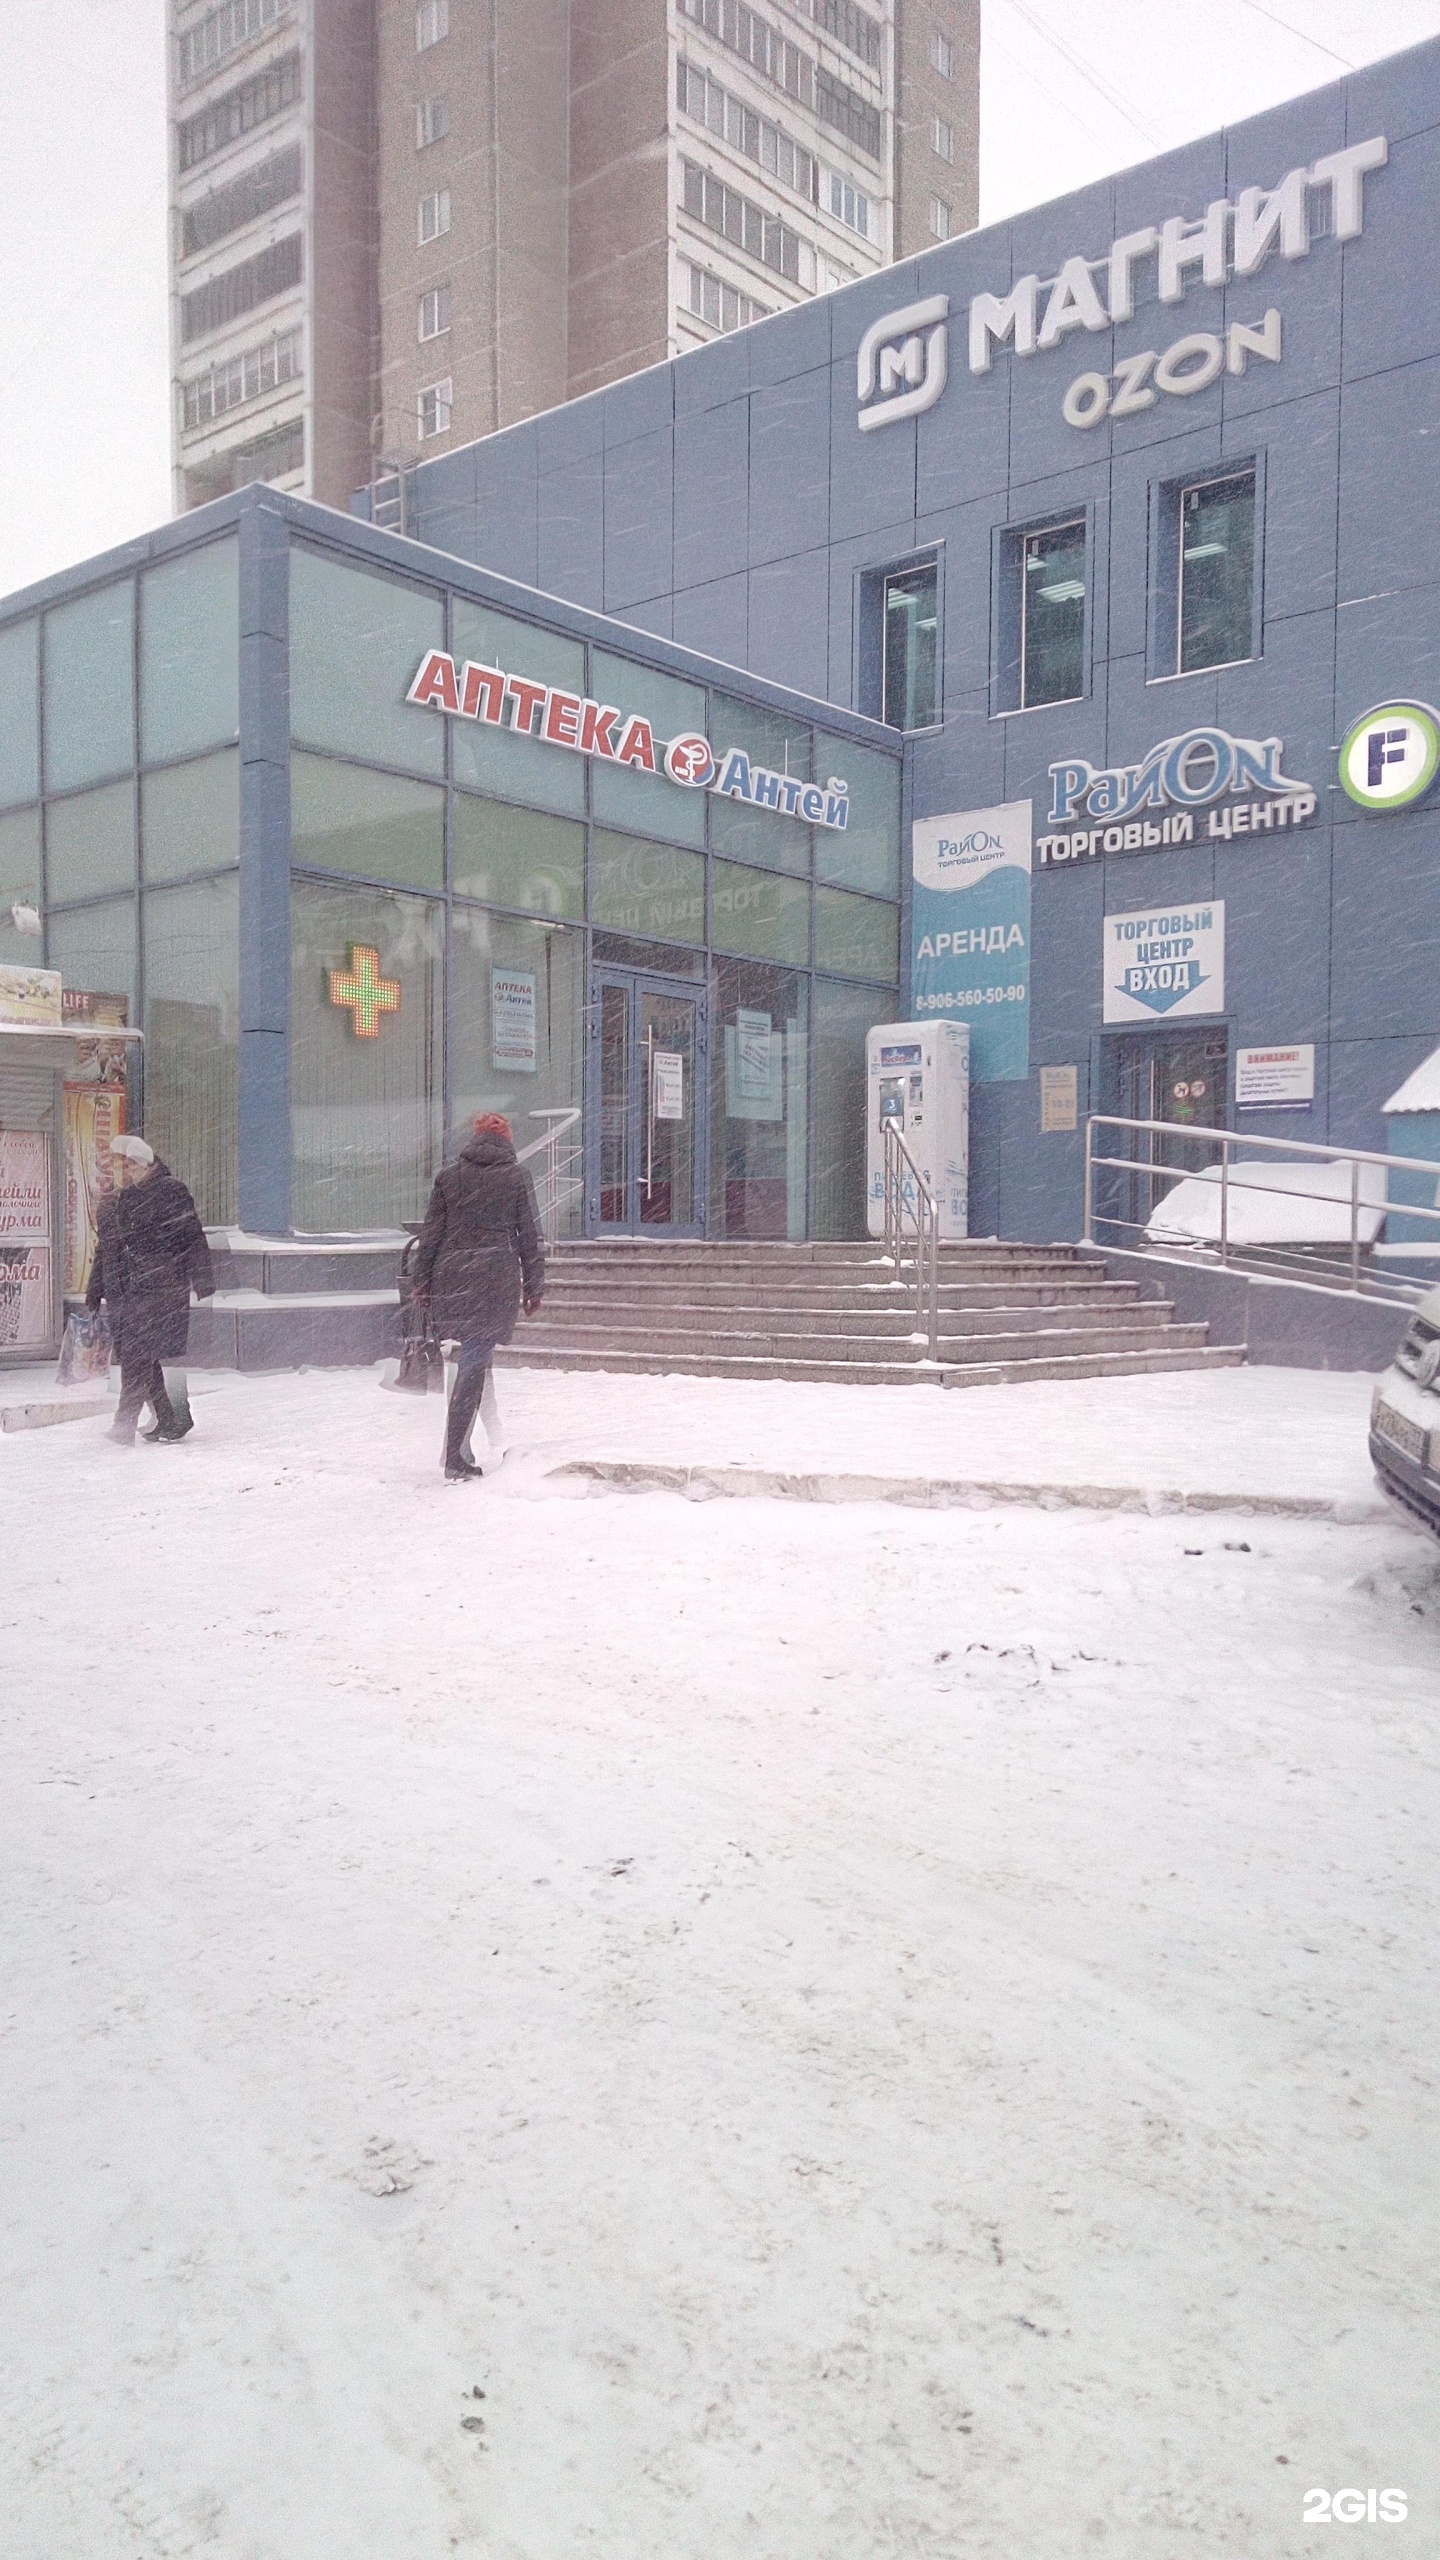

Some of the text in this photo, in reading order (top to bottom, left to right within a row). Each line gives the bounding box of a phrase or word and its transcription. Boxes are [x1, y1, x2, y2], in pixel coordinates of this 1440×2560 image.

[968, 135, 1388, 375] МАГНИТ
[1062, 308, 1282, 430] OZON
[406, 648, 849, 831] АПТЕКА Антей
[1367, 727, 1407, 787] F
[1036, 791, 1319, 864] ТОРГОВЫЙ ЦЕНТР
[916, 923, 1025, 960] АРЕНДА
[1114, 906, 1213, 942] ТОРГОВЫЙ
[1136, 937, 1194, 965] ЦЕНТР
[915, 984, 1026, 1011] 8-906-560-50-90
[1129, 963, 1190, 993] ВХОД
